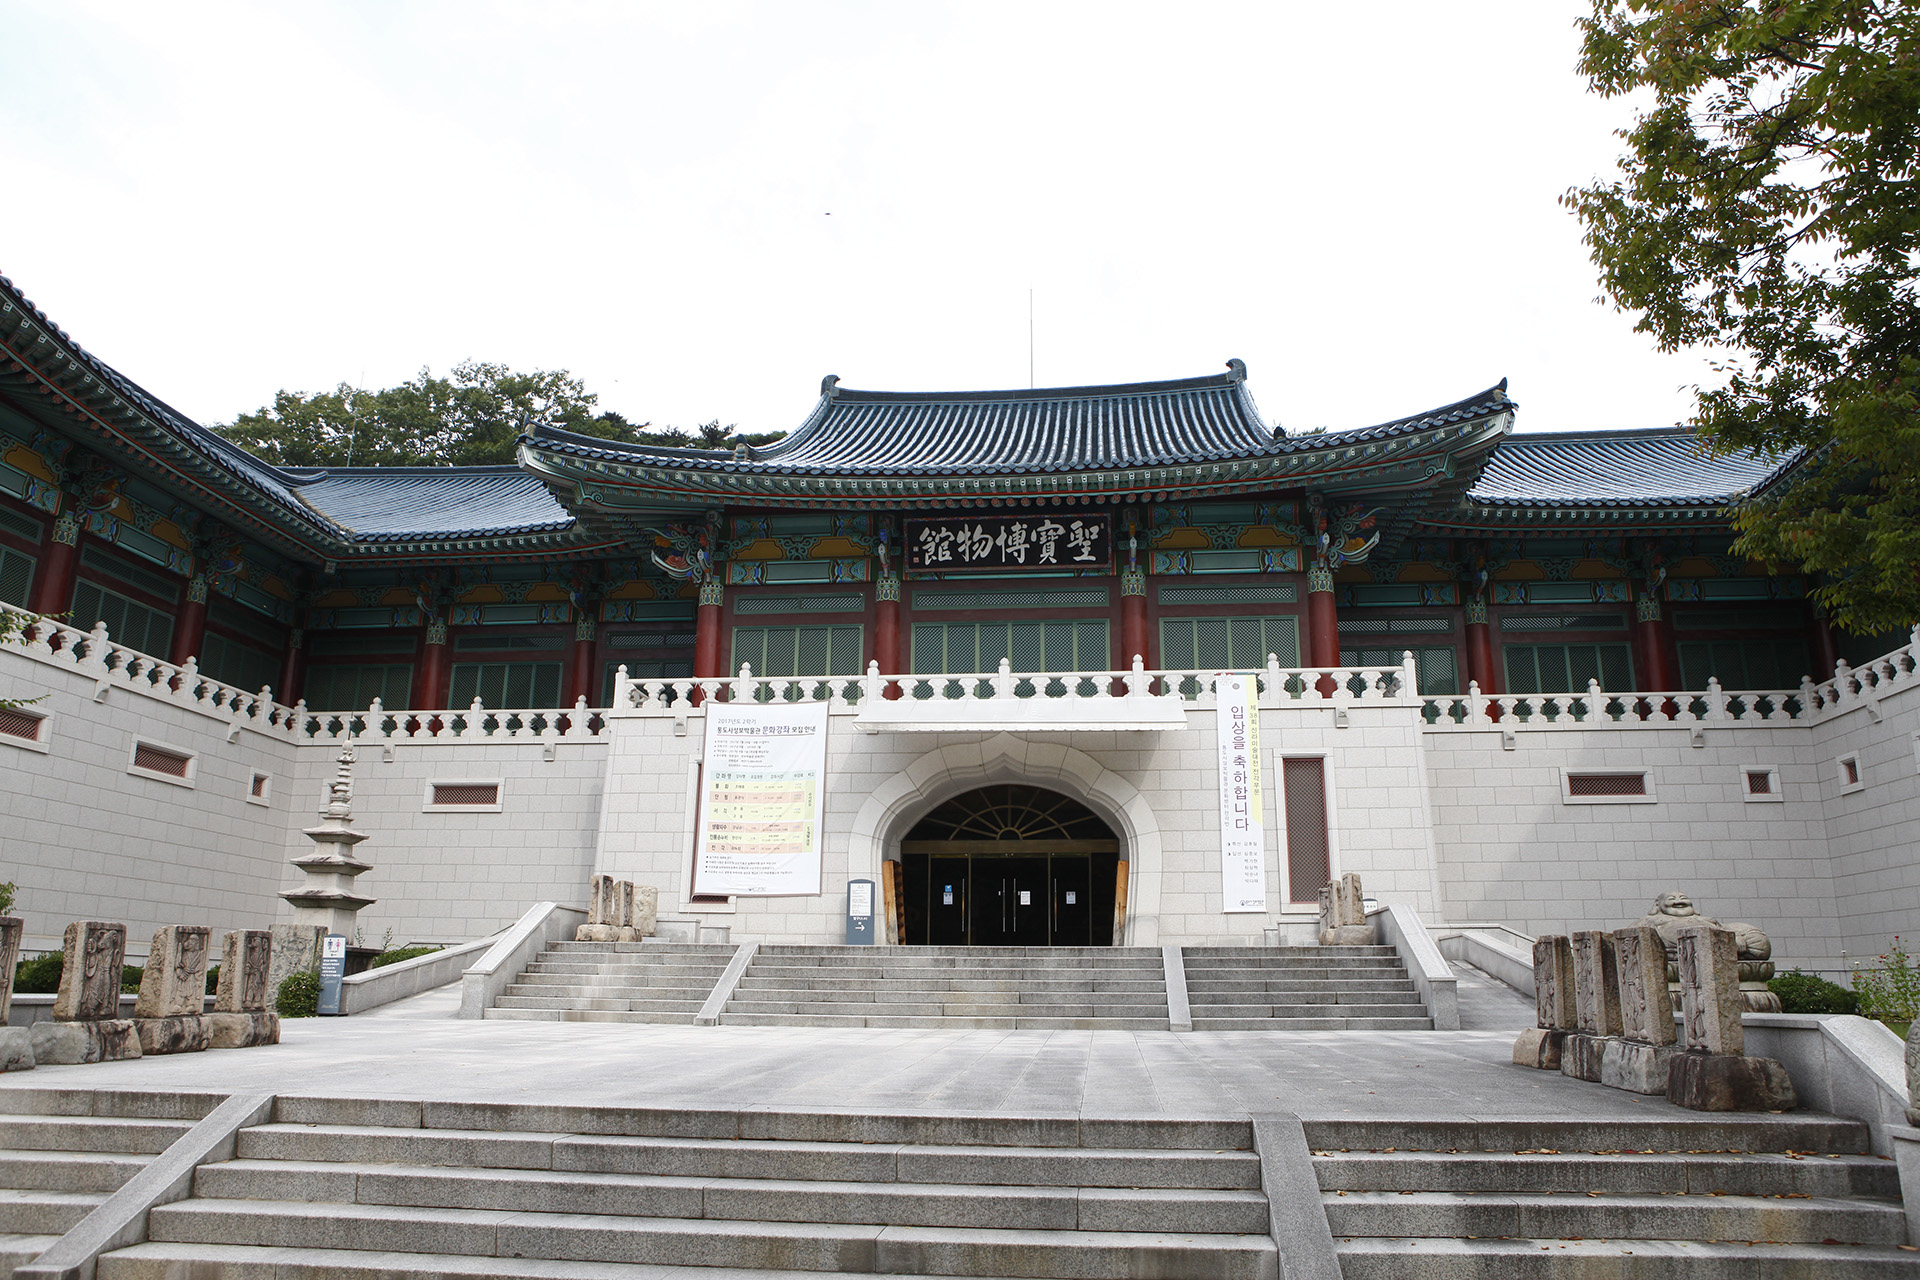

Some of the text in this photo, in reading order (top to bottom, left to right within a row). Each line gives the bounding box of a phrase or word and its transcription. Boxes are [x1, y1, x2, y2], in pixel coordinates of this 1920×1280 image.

[1249, 712, 1258, 725] 38회
[762, 725, 790, 734] 문화강좌
[1231, 705, 1249, 832] 입상을 축하합니다
